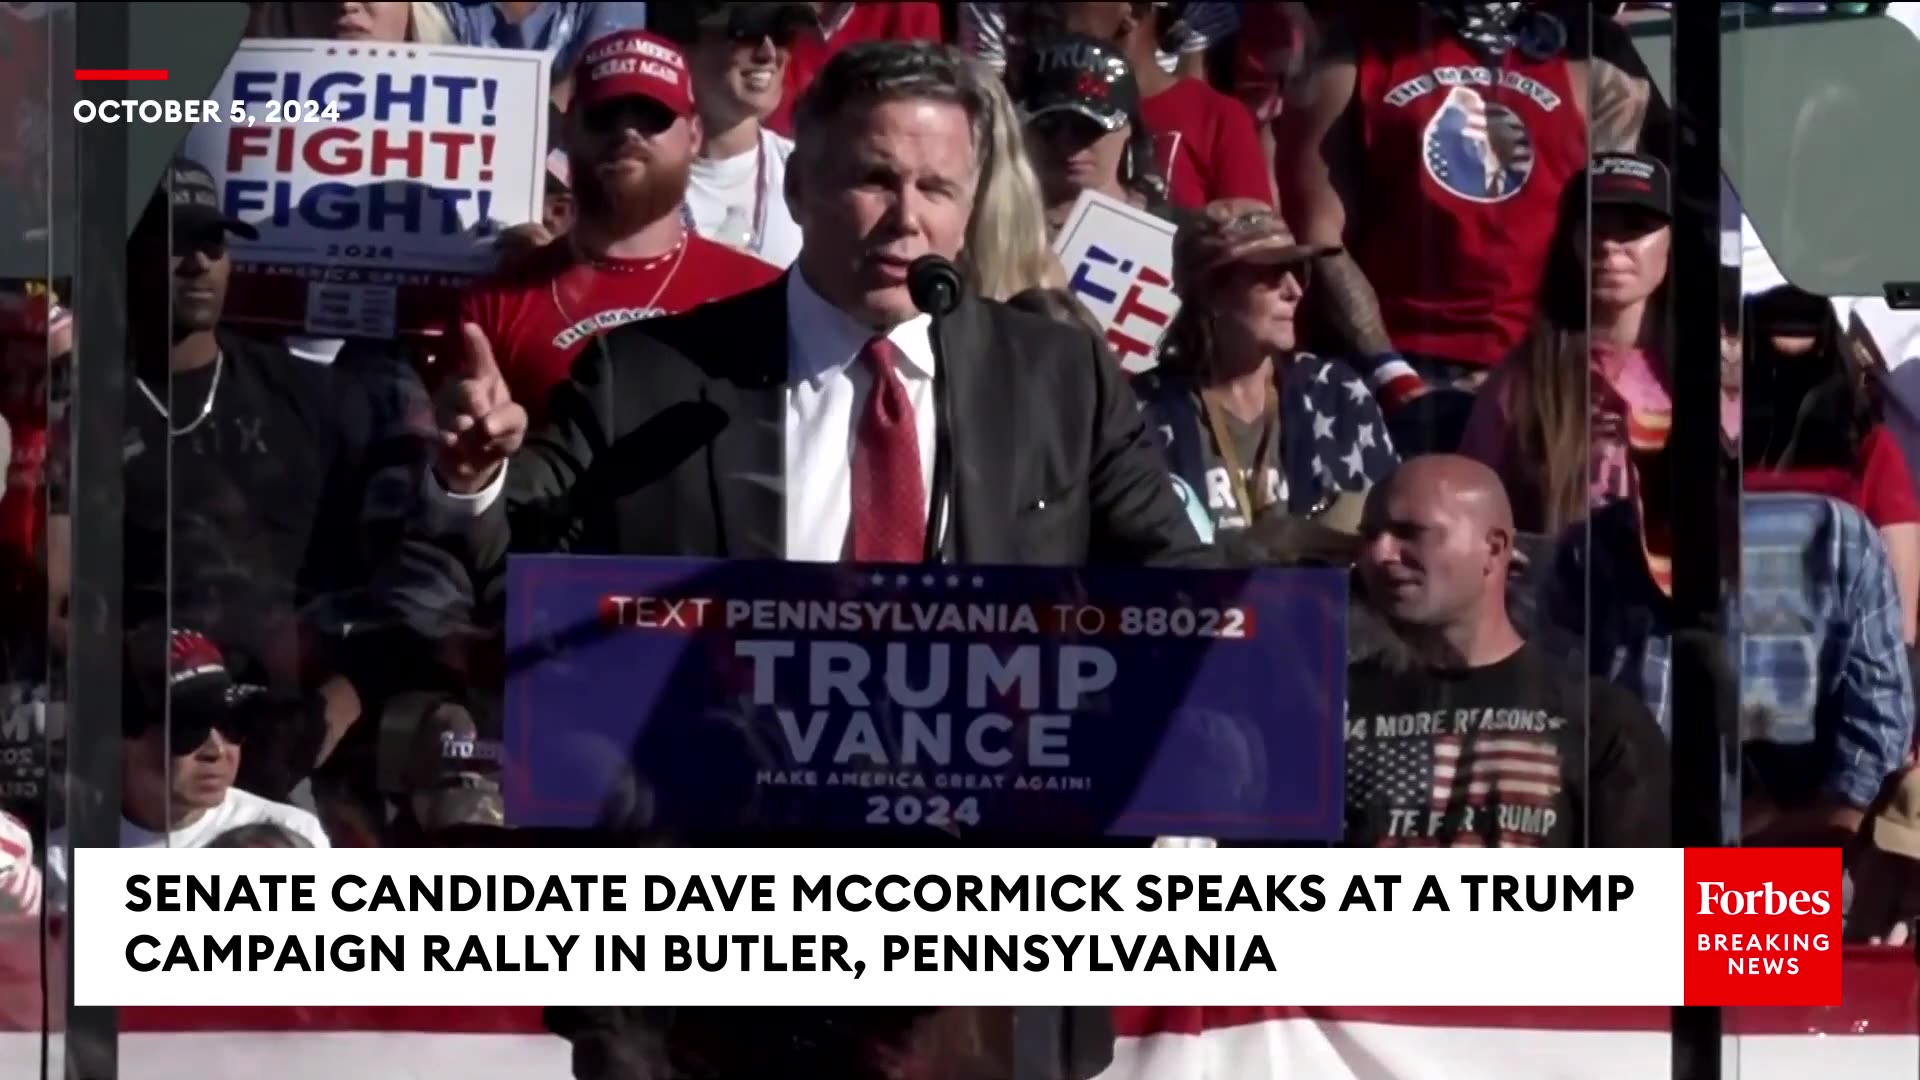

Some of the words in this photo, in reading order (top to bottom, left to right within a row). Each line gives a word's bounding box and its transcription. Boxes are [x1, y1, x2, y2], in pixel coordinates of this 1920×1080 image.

[233, 70, 498, 126] FIGHT!
[1384, 74, 1436, 107] THE
[1433, 65, 1503, 87] MAG
[226, 127, 496, 182] FIGHT!
[223, 179, 492, 237] FIGHT!
[326, 243, 393, 259] 2024
[552, 318, 598, 349] THE
[610, 596, 712, 628] TEXT
[726, 599, 1039, 633] PENNSYLVANIA
[1053, 604, 1105, 635] TO
[1119, 605, 1246, 638] 88022
[735, 640, 1117, 710] TRUMP
[777, 709, 1071, 768] VANCE
[1376, 709, 1447, 738] MORE
[757, 770, 817, 786] MAKE
[826, 772, 926, 788] AMERICA
[935, 774, 1004, 790] GREAT
[1014, 776, 1092, 791] AGAIN!
[866, 796, 980, 826] 2024
[1427, 807, 1475, 837] FR
[1480, 803, 1557, 837] RUMP
